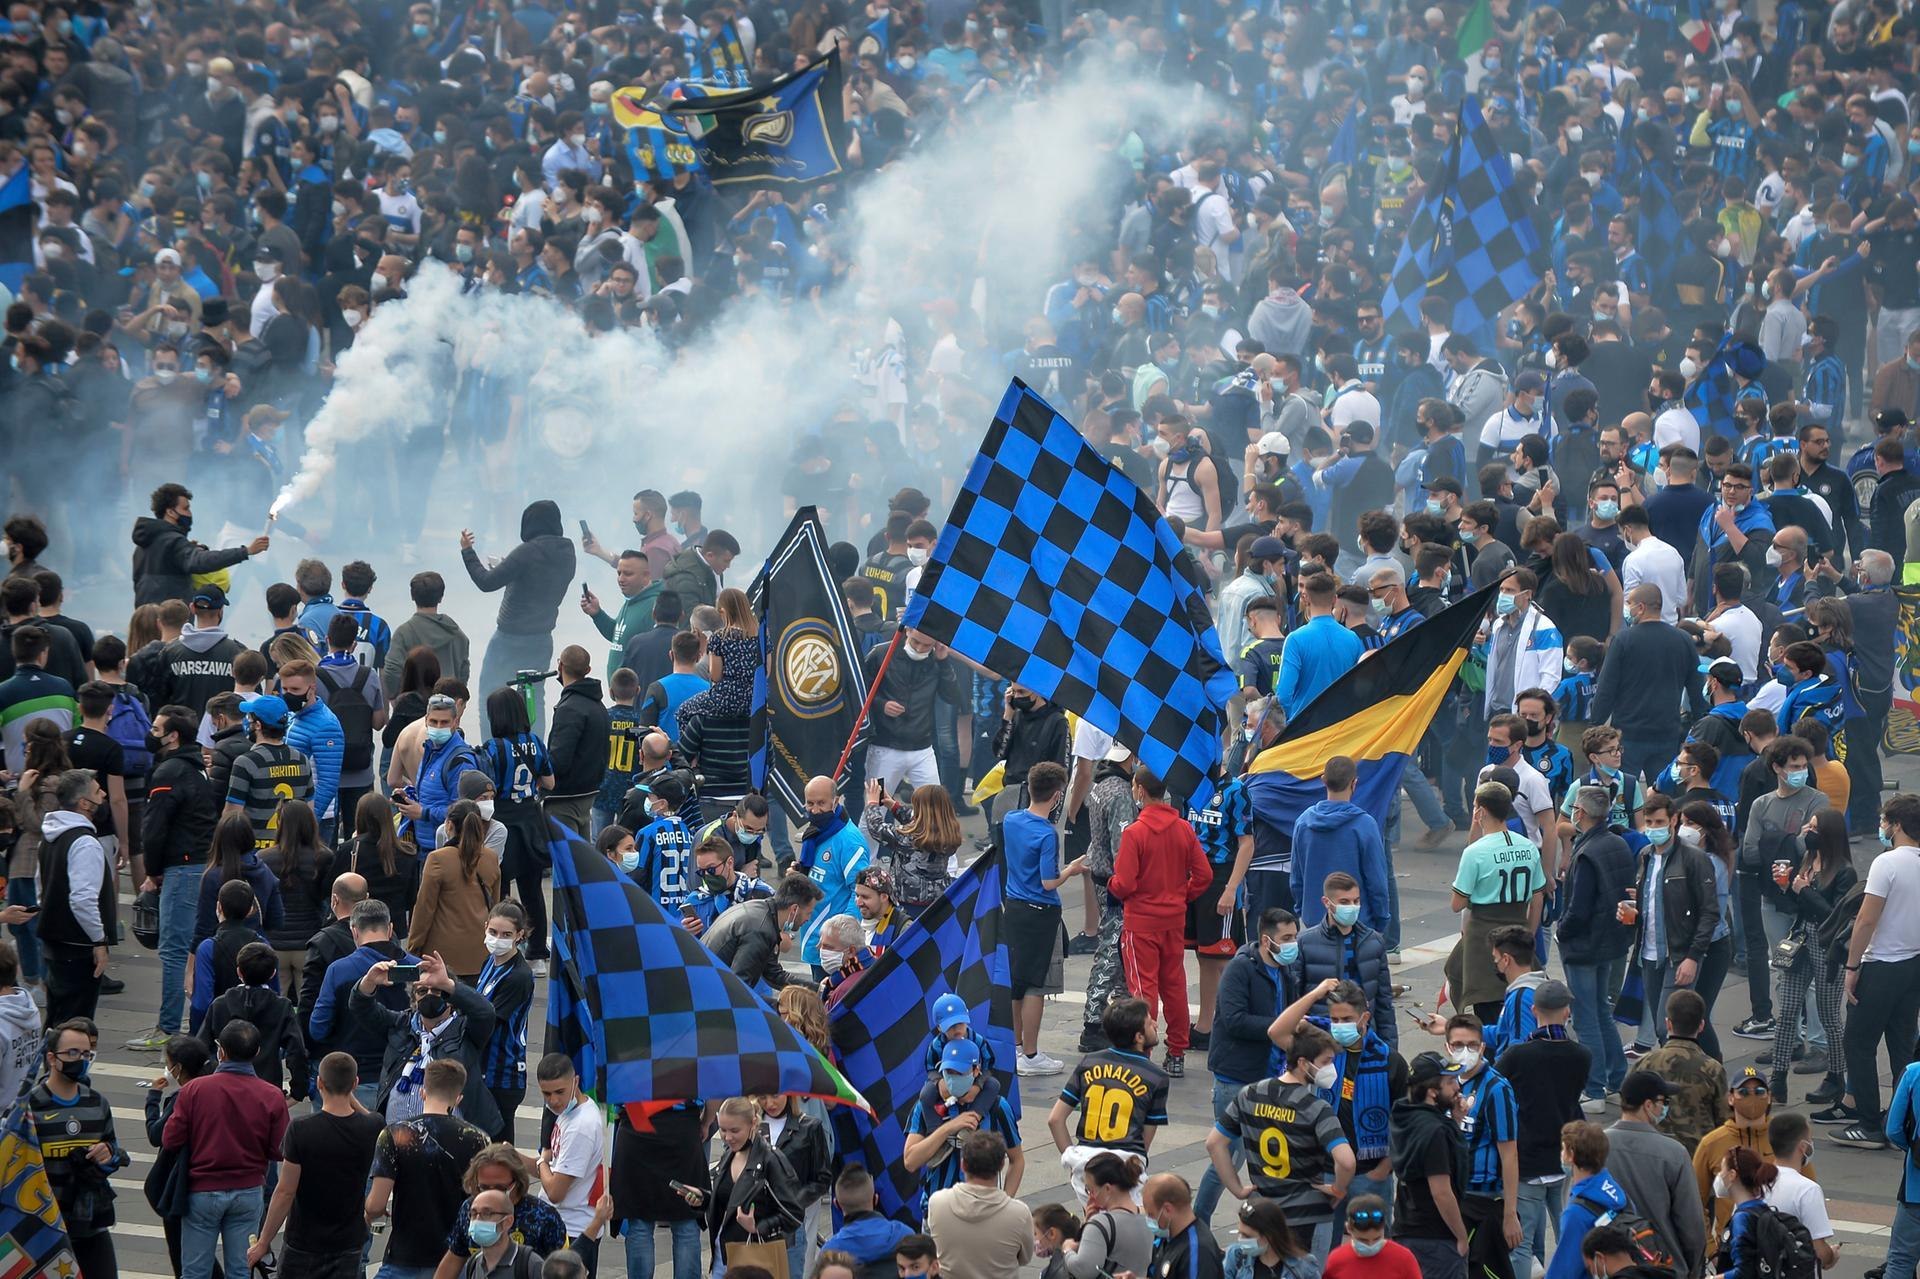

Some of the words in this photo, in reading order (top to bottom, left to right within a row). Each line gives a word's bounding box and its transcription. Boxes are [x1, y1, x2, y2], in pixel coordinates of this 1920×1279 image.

[864, 567, 894, 584] LUKAKU
[170, 660, 233, 678] WARSZAWA
[269, 765, 301, 779] HAKIMI
[1493, 852, 1533, 866] LAUTARO
[1498, 866, 1532, 904] 10
[1083, 1062, 1149, 1098] RONALDO
[1083, 1084, 1134, 1141] 10
[1253, 1102, 1296, 1124] LUKAKU
[1259, 1126, 1291, 1179] 9
